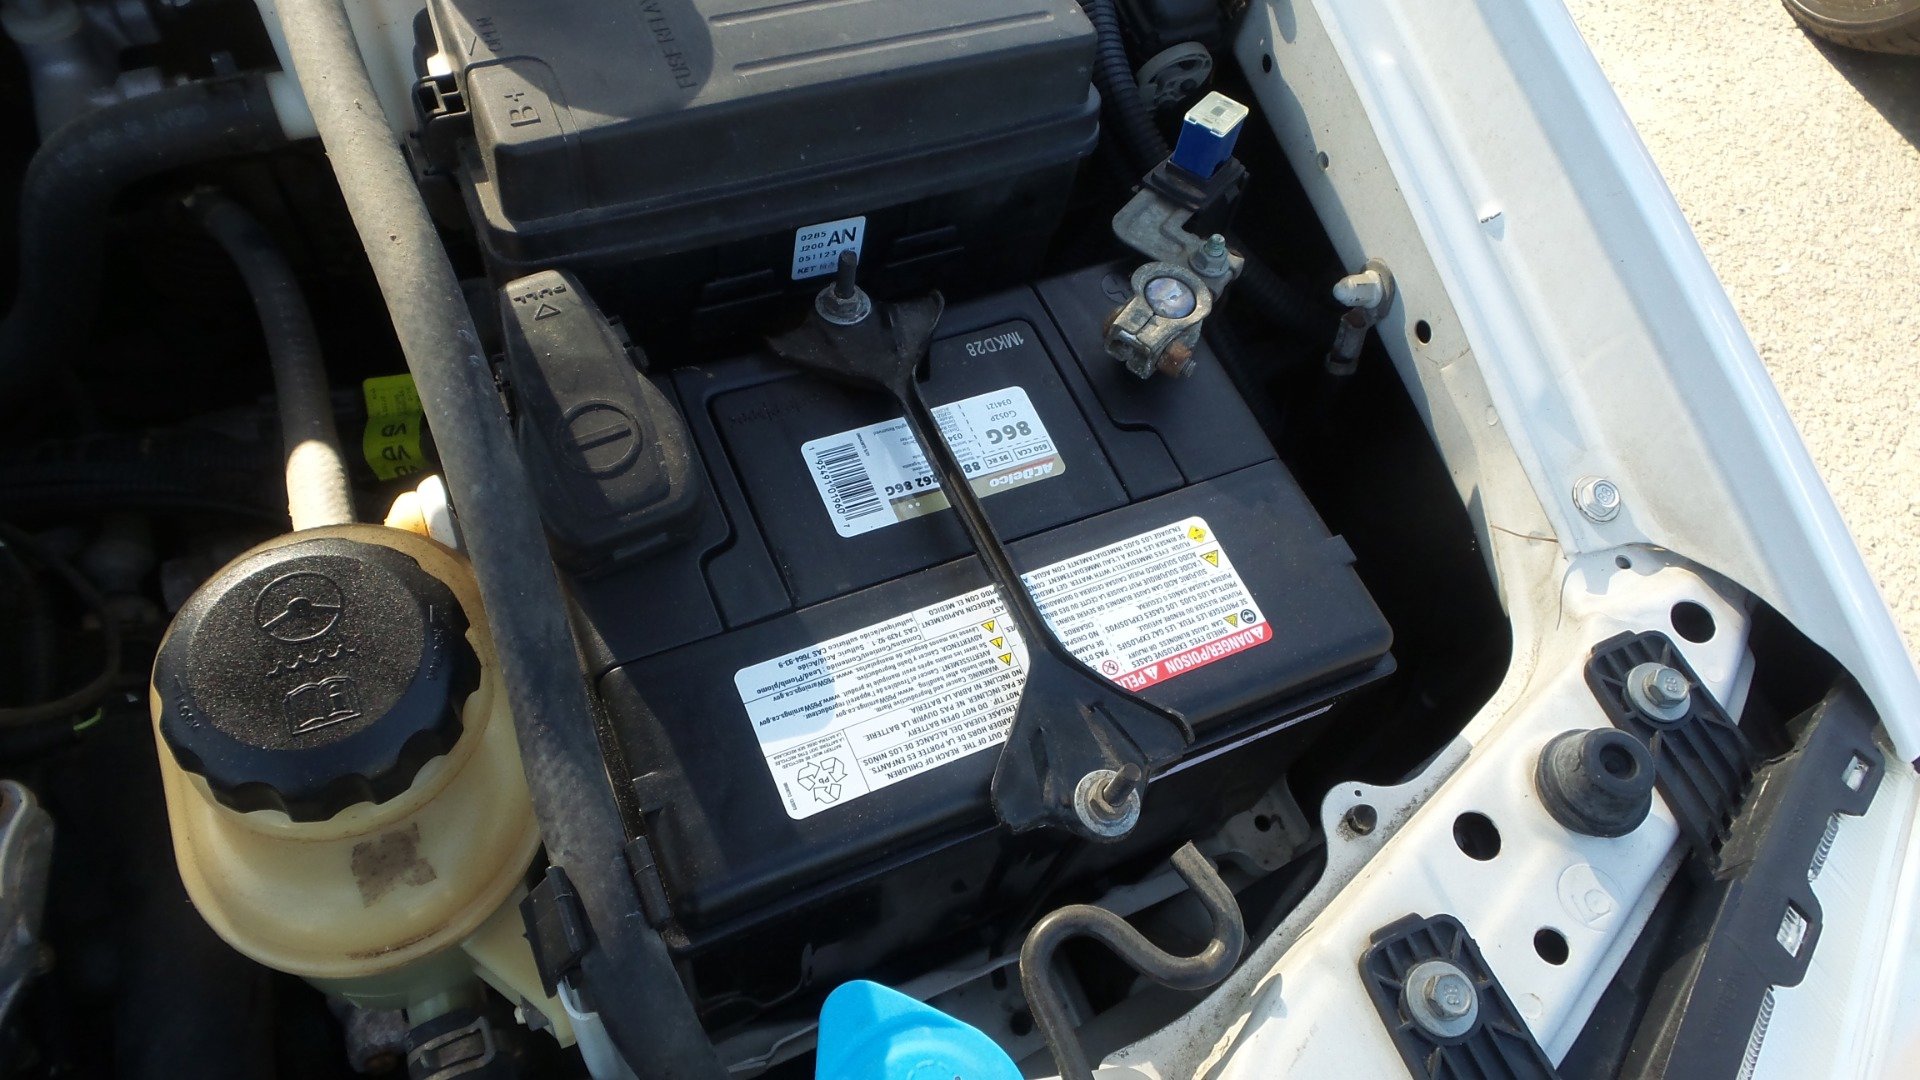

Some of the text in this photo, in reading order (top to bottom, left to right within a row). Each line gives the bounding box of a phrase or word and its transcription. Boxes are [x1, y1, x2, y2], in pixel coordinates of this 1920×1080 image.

[503, 88, 541, 127] B+
[800, 226, 857, 247] 0285 AN
[798, 250, 837, 263] 051123
[965, 331, 1024, 357] 1MKD28
[984, 397, 1012, 410] 034121
[984, 419, 1033, 445] 86G
[1016, 447, 1032, 456] CCA
[1032, 443, 1047, 451] 650
[381, 445, 412, 461] VD
[987, 460, 1057, 490] ACDelco
[883, 479, 913, 496] 86G
[1162, 629, 1255, 674] DANGER/POISON
[1004, 690, 1020, 700] NOT
[961, 706, 977, 716] NOT
[976, 701, 988, 711] DO
[939, 712, 961, 724] OPEN
[966, 725, 988, 739] HORS
[987, 730, 1003, 741] OUT
[945, 737, 956, 747] LA
[956, 733, 967, 743] DE
[976, 736, 987, 745] OF
[961, 741, 976, 751] THE
[905, 752, 917, 762] ES
[934, 747, 960, 761] REACH
[924, 756, 934, 765] OF
[817, 775, 830, 785] Pb
